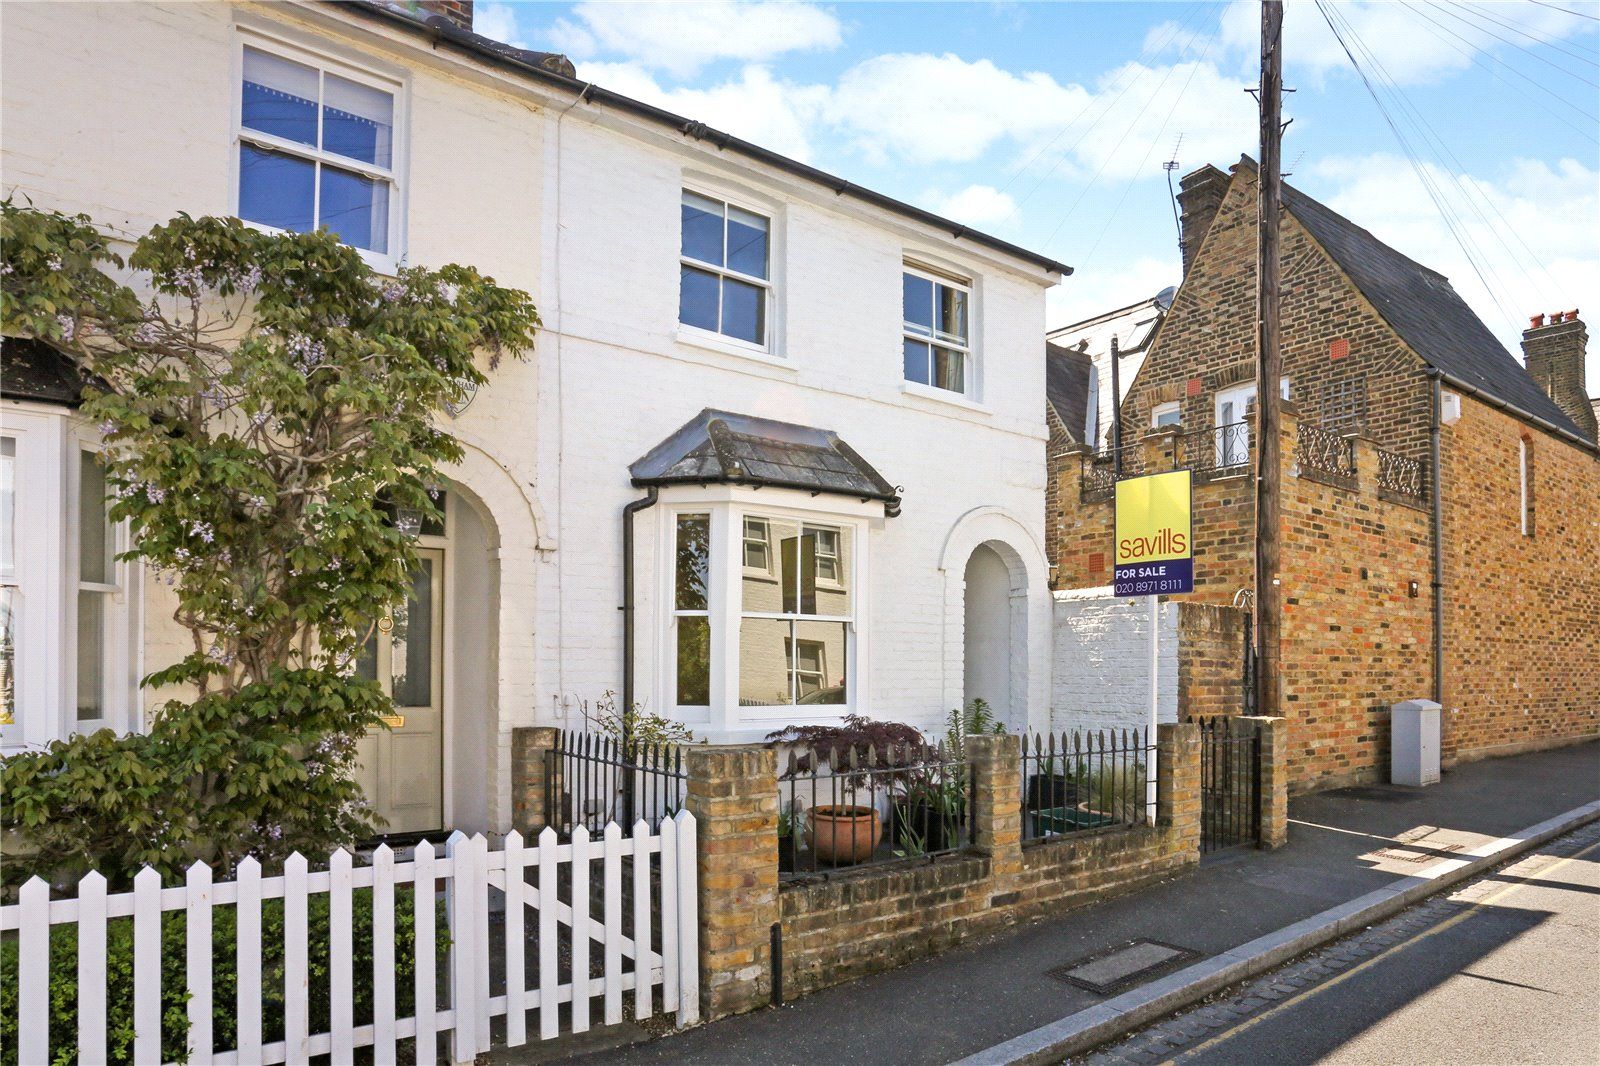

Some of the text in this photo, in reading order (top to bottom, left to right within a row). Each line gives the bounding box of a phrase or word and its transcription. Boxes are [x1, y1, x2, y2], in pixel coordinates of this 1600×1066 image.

[1120, 528, 1186, 559] savills
[1115, 566, 1166, 580] FOR SALE
[1115, 579, 1182, 594] 020 8971 8111
